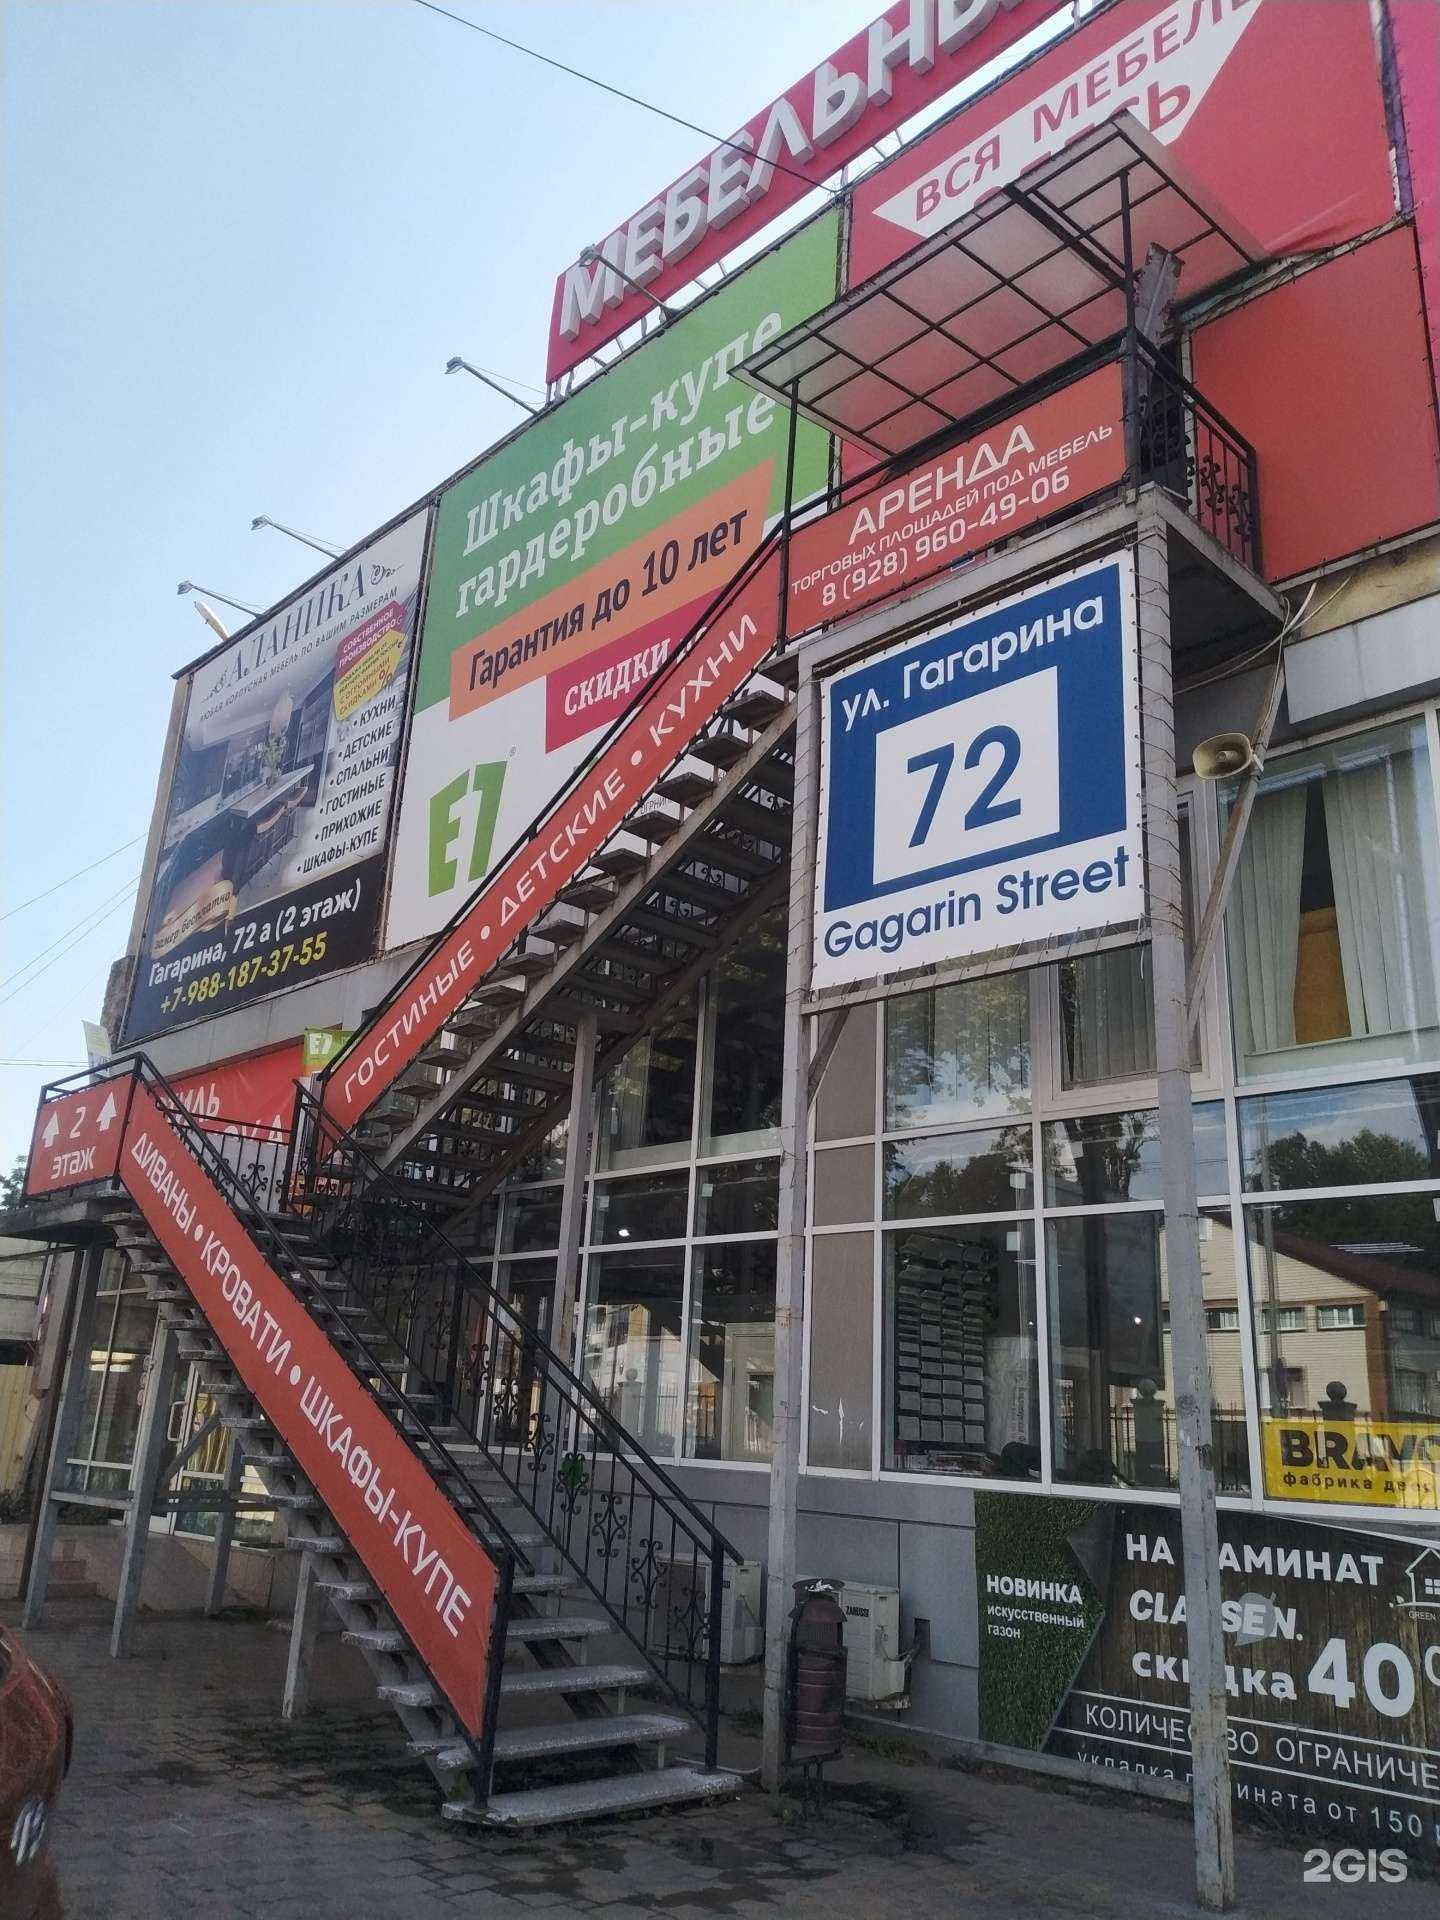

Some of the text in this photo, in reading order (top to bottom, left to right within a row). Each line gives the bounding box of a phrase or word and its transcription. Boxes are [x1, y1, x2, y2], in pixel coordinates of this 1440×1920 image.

[915, 135, 1000, 221] ВСЯ
[1033, 0, 1252, 143] МЕБЕЛ
[463, 312, 782, 558] Шкафы-купе
[456, 391, 776, 618] гардеробные
[792, 425, 1113, 595] ТОРГОВЫХ ПЛОЩАДЕЙ ПОД МЕБЕЛЬ
[848, 424, 1036, 546] АРЕНДА
[822, 465, 1070, 607] 8 (928) 960-49-06
[301, 642, 313, 656] ПО
[315, 619, 347, 648] ВАШИМ
[349, 585, 398, 626] РАЗМЕРАМ
[468, 602, 585, 692] Гарантия
[592, 578, 630, 631] до
[642, 539, 680, 597] 10
[688, 509, 748, 571] лет
[343, 607, 394, 654] СОБСТВЕННОЕ
[841, 595, 1104, 731] ул. Гагарина
[359, 695, 397, 728] КУХНИ
[336, 747, 389, 787] СПАЛЬНИ
[343, 721, 393, 762] ДЕТСКИЕ
[325, 773, 386, 815] ГОСТИНЫЕ
[906, 725, 1022, 849] 72
[321, 800, 383, 842] ПРИХОЖИЕ
[303, 826, 379, 874] ШКАФЫ-КУПЕ
[343, 614, 758, 1104] ГОСТИНЫЕ ДЕТСКИЕ КУХНИ
[824, 845, 1130, 957] Gagarin Street
[149, 878, 362, 987] Гагарина, 72 а (2 этаж)
[160, 931, 328, 1015] +7-988-187-37-55
[70, 1106, 86, 1139] 2
[131, 1133, 198, 1235] ДИВАНЫ
[200, 1230, 293, 1376] КРОВАТИ
[299, 1376, 472, 1638] ШКАФЫ-КУПЕ
[1283, 1472, 1373, 1490] фабрика
[1126, 1533, 1385, 1586] НА АМИНАТ
[986, 1574, 1083, 1605] НОВИНКА
[987, 1605, 1086, 1629] искусственный
[1130, 1589, 1304, 1641] CLASEN.
[987, 1624, 1021, 1639] газон
[1276, 1736, 1440, 1791] ОГРАНИЧЕ
[1328, 1802, 1358, 1824] от
[1370, 1806, 1423, 1838] 150
